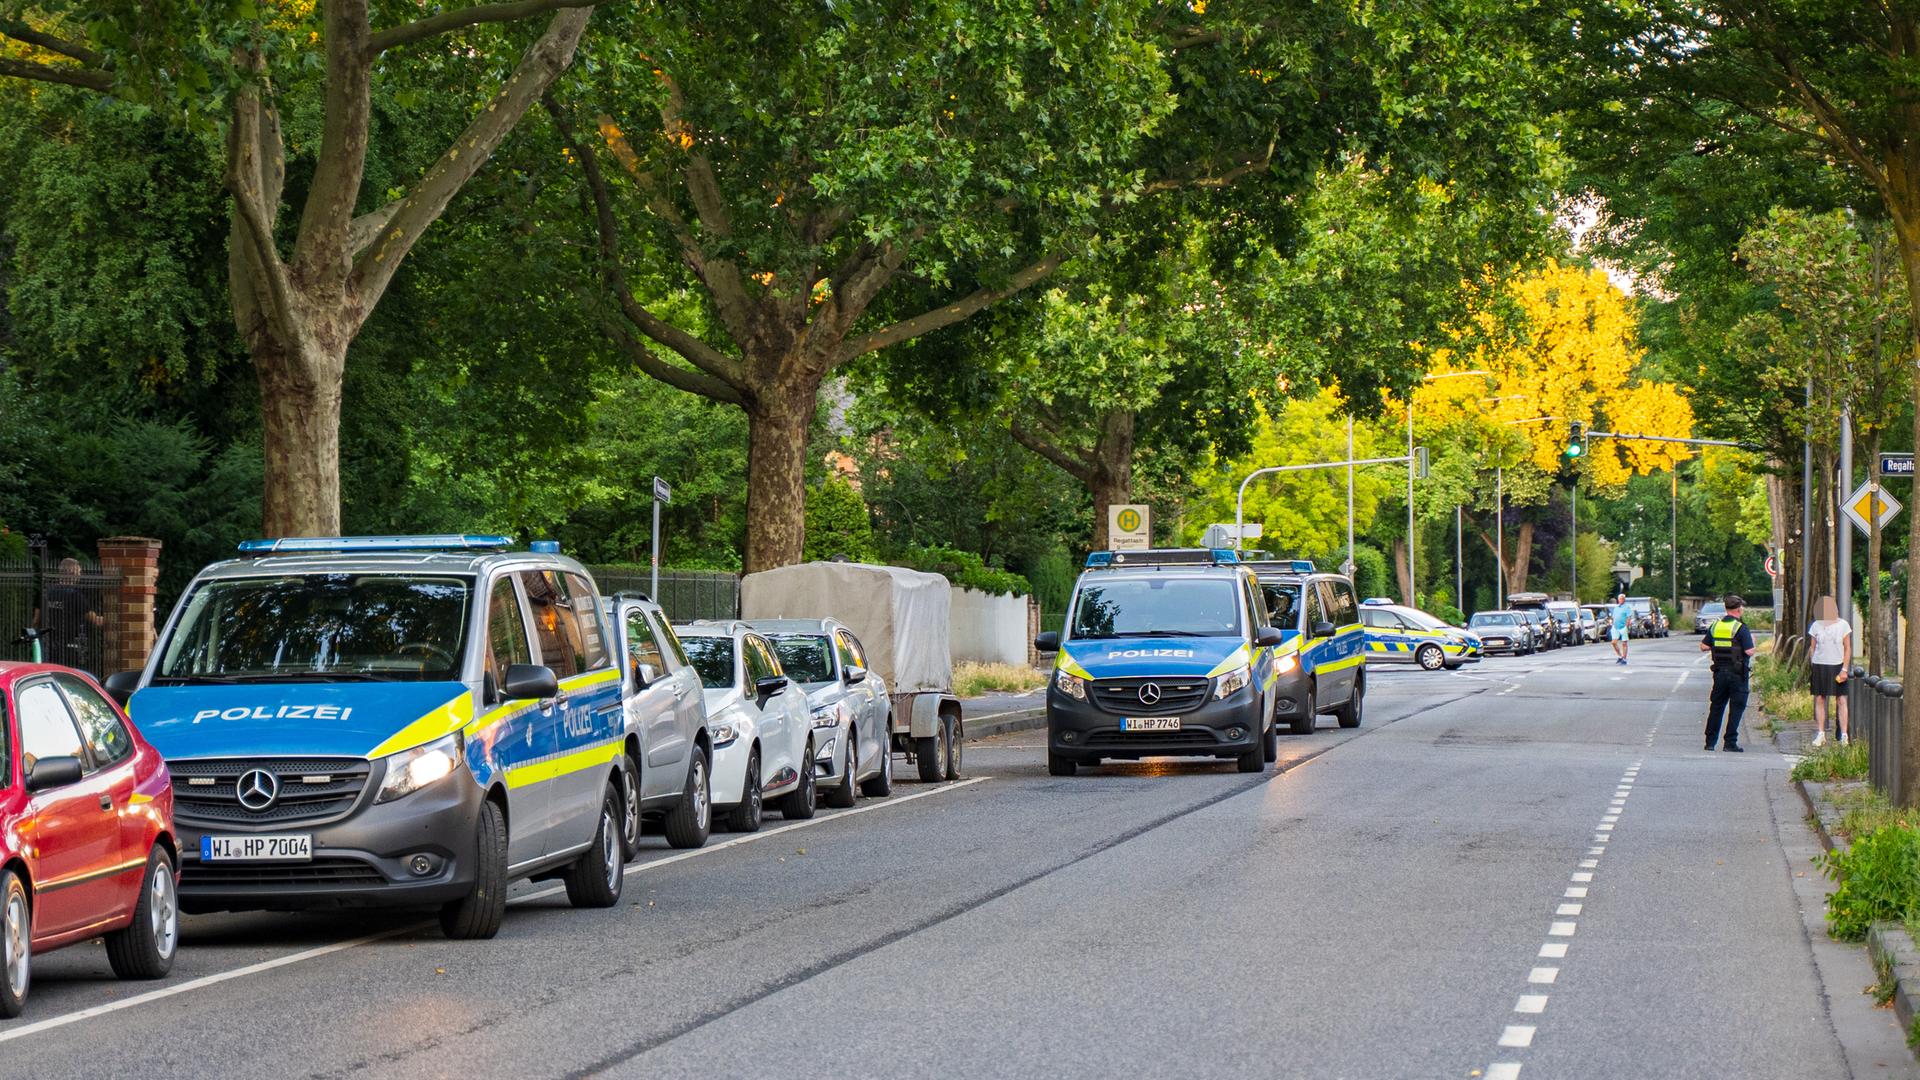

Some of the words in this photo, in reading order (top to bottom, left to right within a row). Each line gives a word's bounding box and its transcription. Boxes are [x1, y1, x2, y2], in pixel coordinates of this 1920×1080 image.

[1123, 514, 1135, 527] H
[1108, 649, 1194, 659] POLIZEI
[192, 705, 353, 724] POLIZEI
[563, 704, 593, 738] POLIZEI
[1126, 719, 1137, 729] WI
[1144, 719, 1156, 729] HP
[1157, 719, 1179, 729] 7746
[213, 839, 232, 857] WI
[244, 839, 265, 857] HP
[269, 838, 309, 856] 7004
